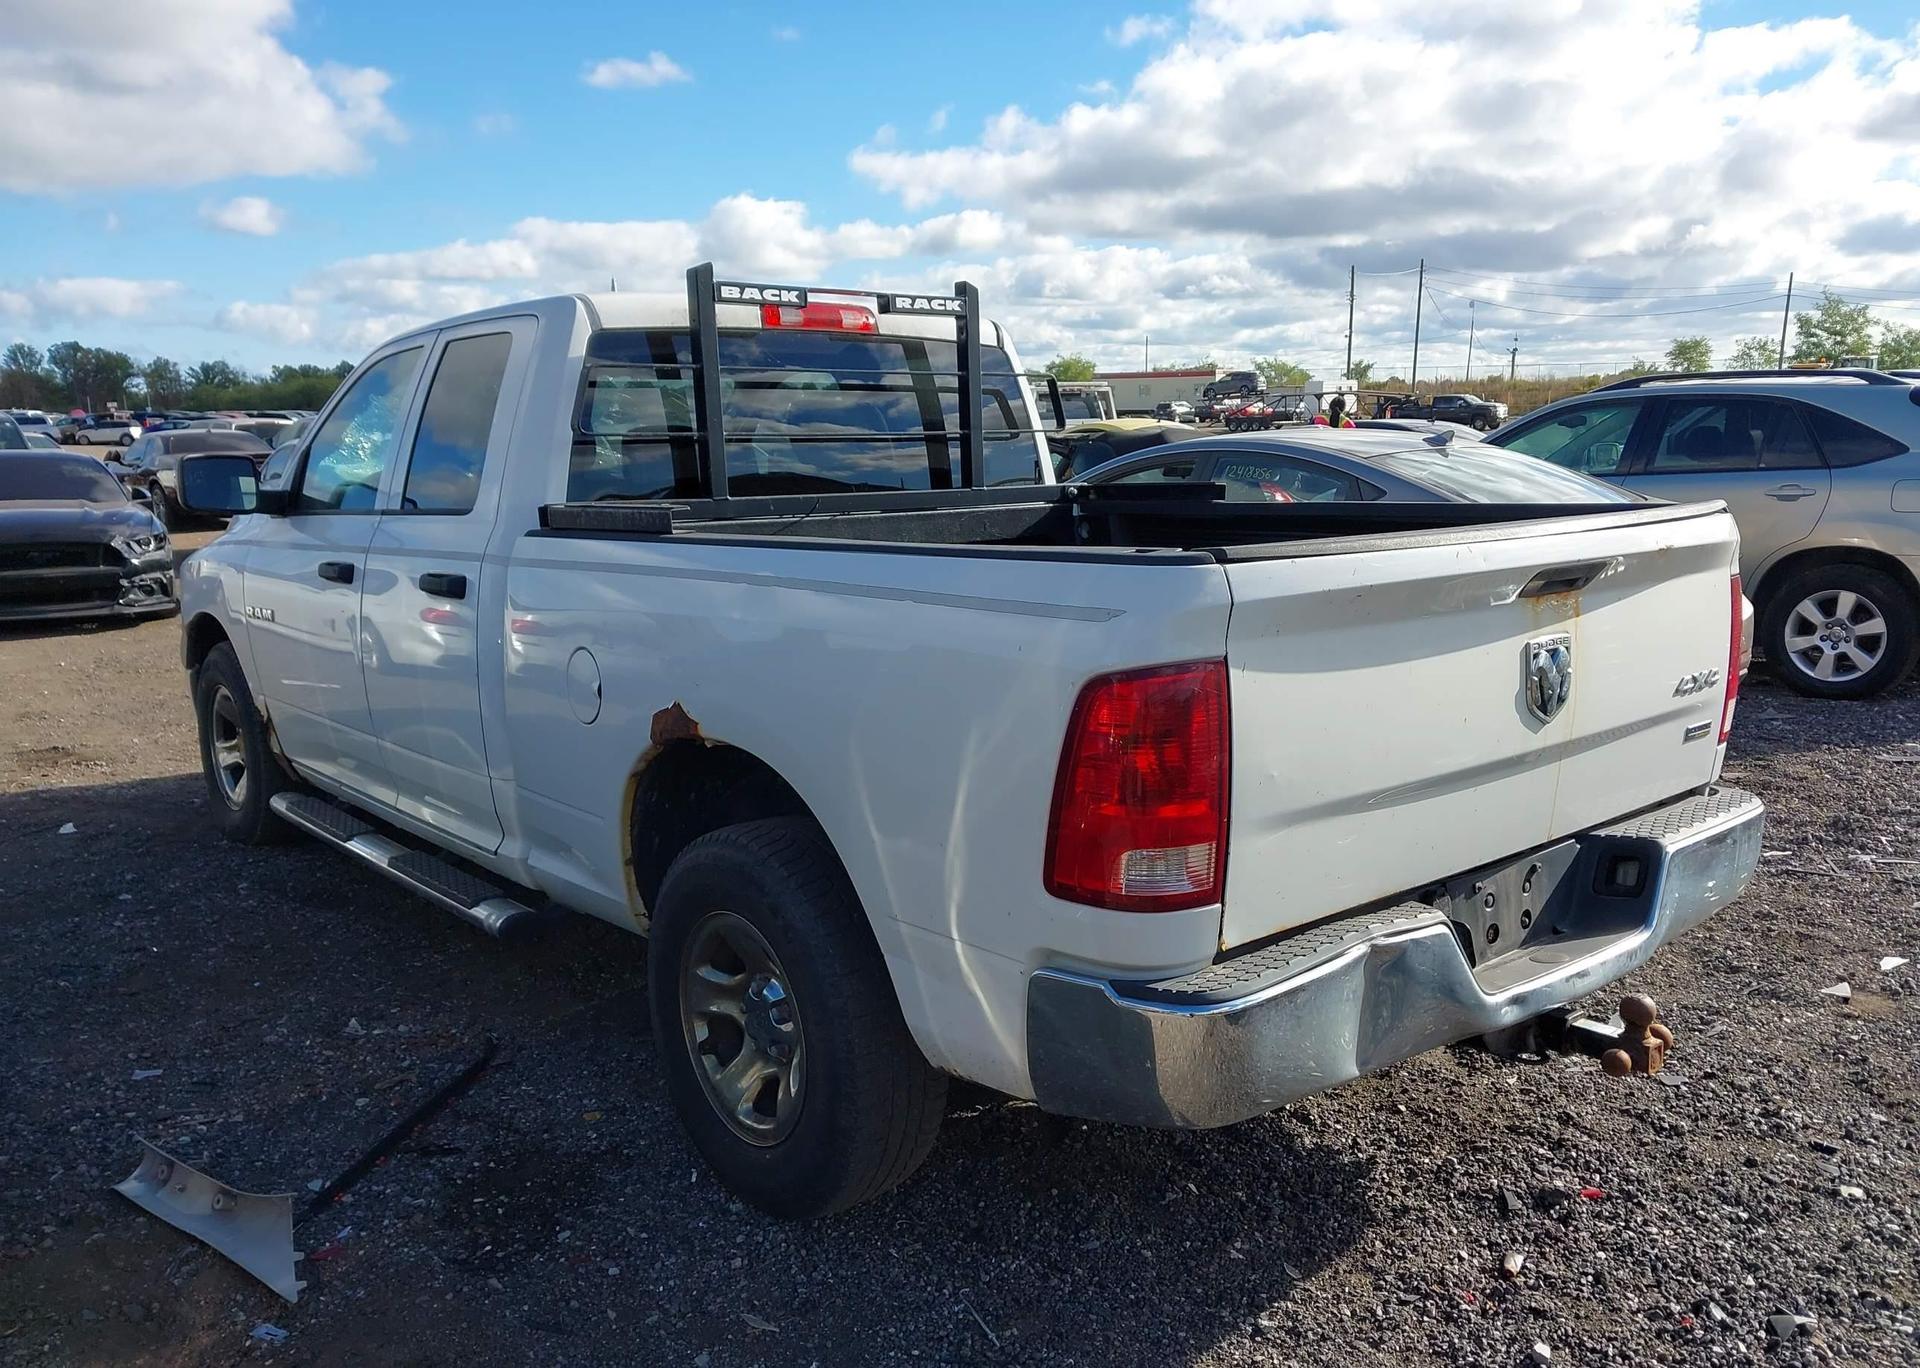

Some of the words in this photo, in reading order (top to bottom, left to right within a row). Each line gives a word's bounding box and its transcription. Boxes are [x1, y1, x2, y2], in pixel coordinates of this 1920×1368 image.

[720, 285, 800, 303] BACK
[895, 297, 963, 312] RACK
[1225, 465, 1273, 480] 12418856
[246, 606, 275, 621] RAM
[1532, 636, 1569, 651] DODGE
